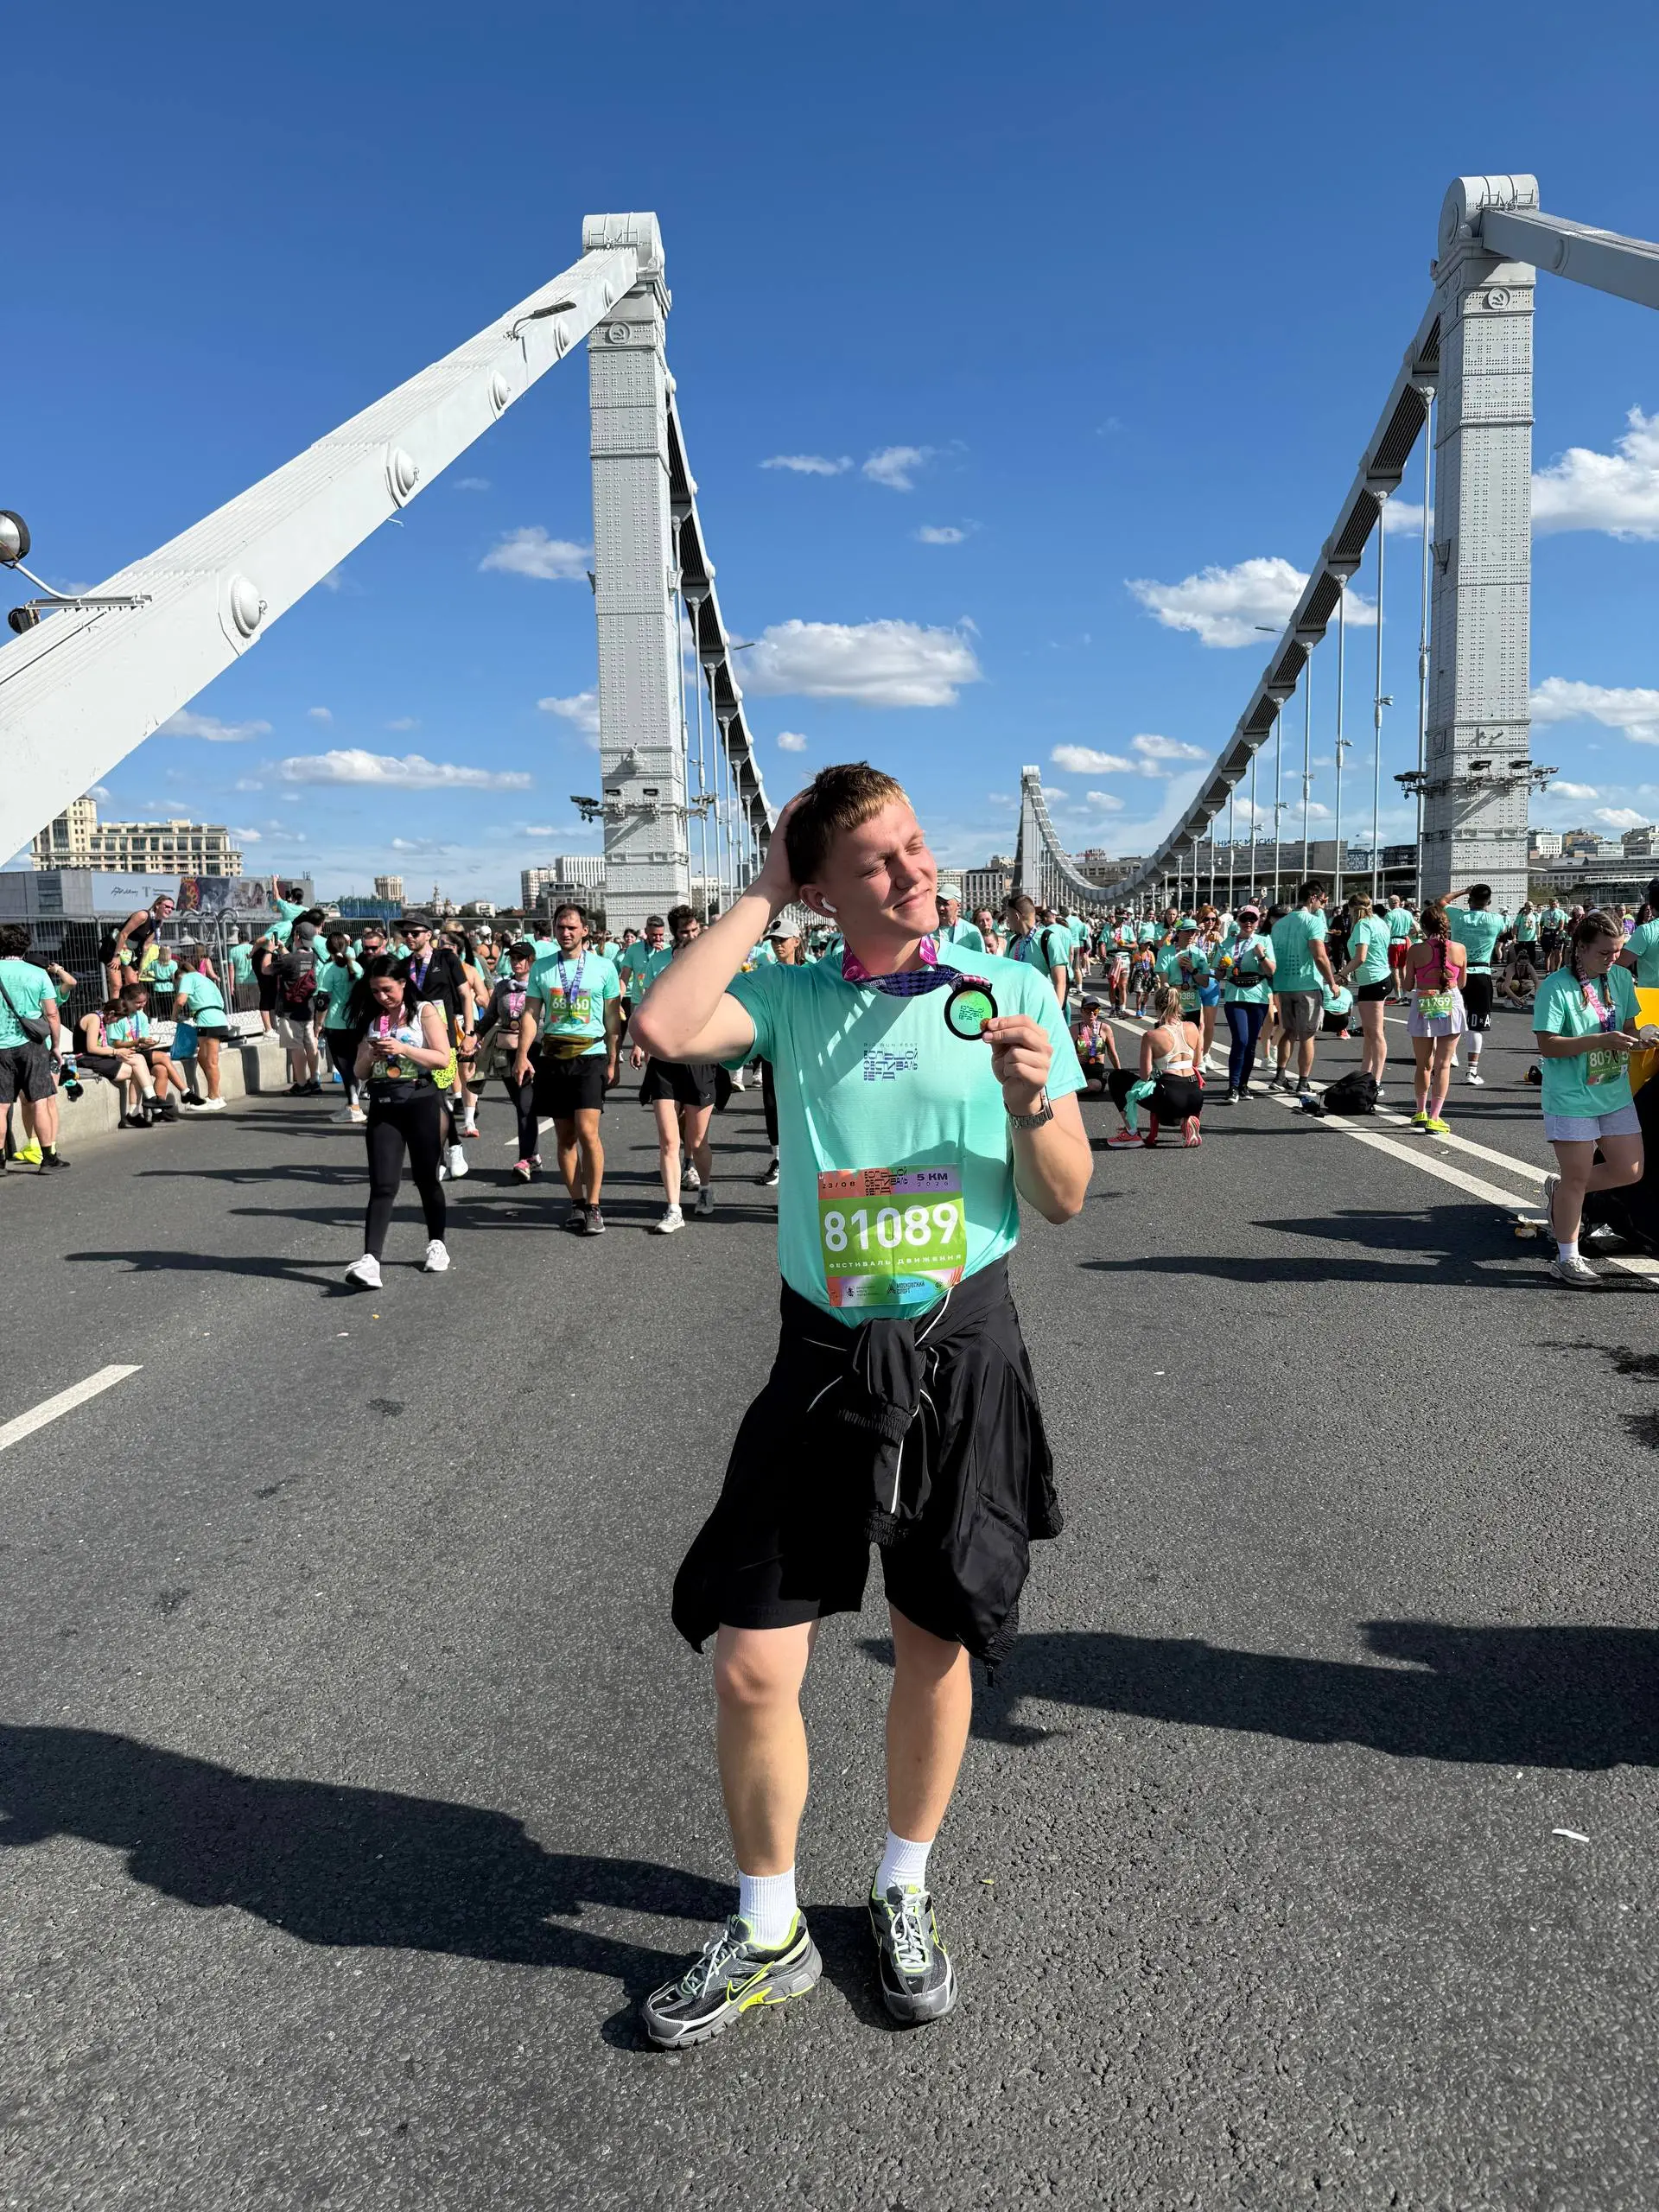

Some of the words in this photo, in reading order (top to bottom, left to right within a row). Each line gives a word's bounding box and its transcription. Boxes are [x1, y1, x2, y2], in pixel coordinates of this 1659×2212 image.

[824, 1203, 958, 1252] 81089
[829, 1260, 892, 1268] ФЕСТИВАЛЬ
[898, 1254, 962, 1265] ДВИЖЕНИЯ
